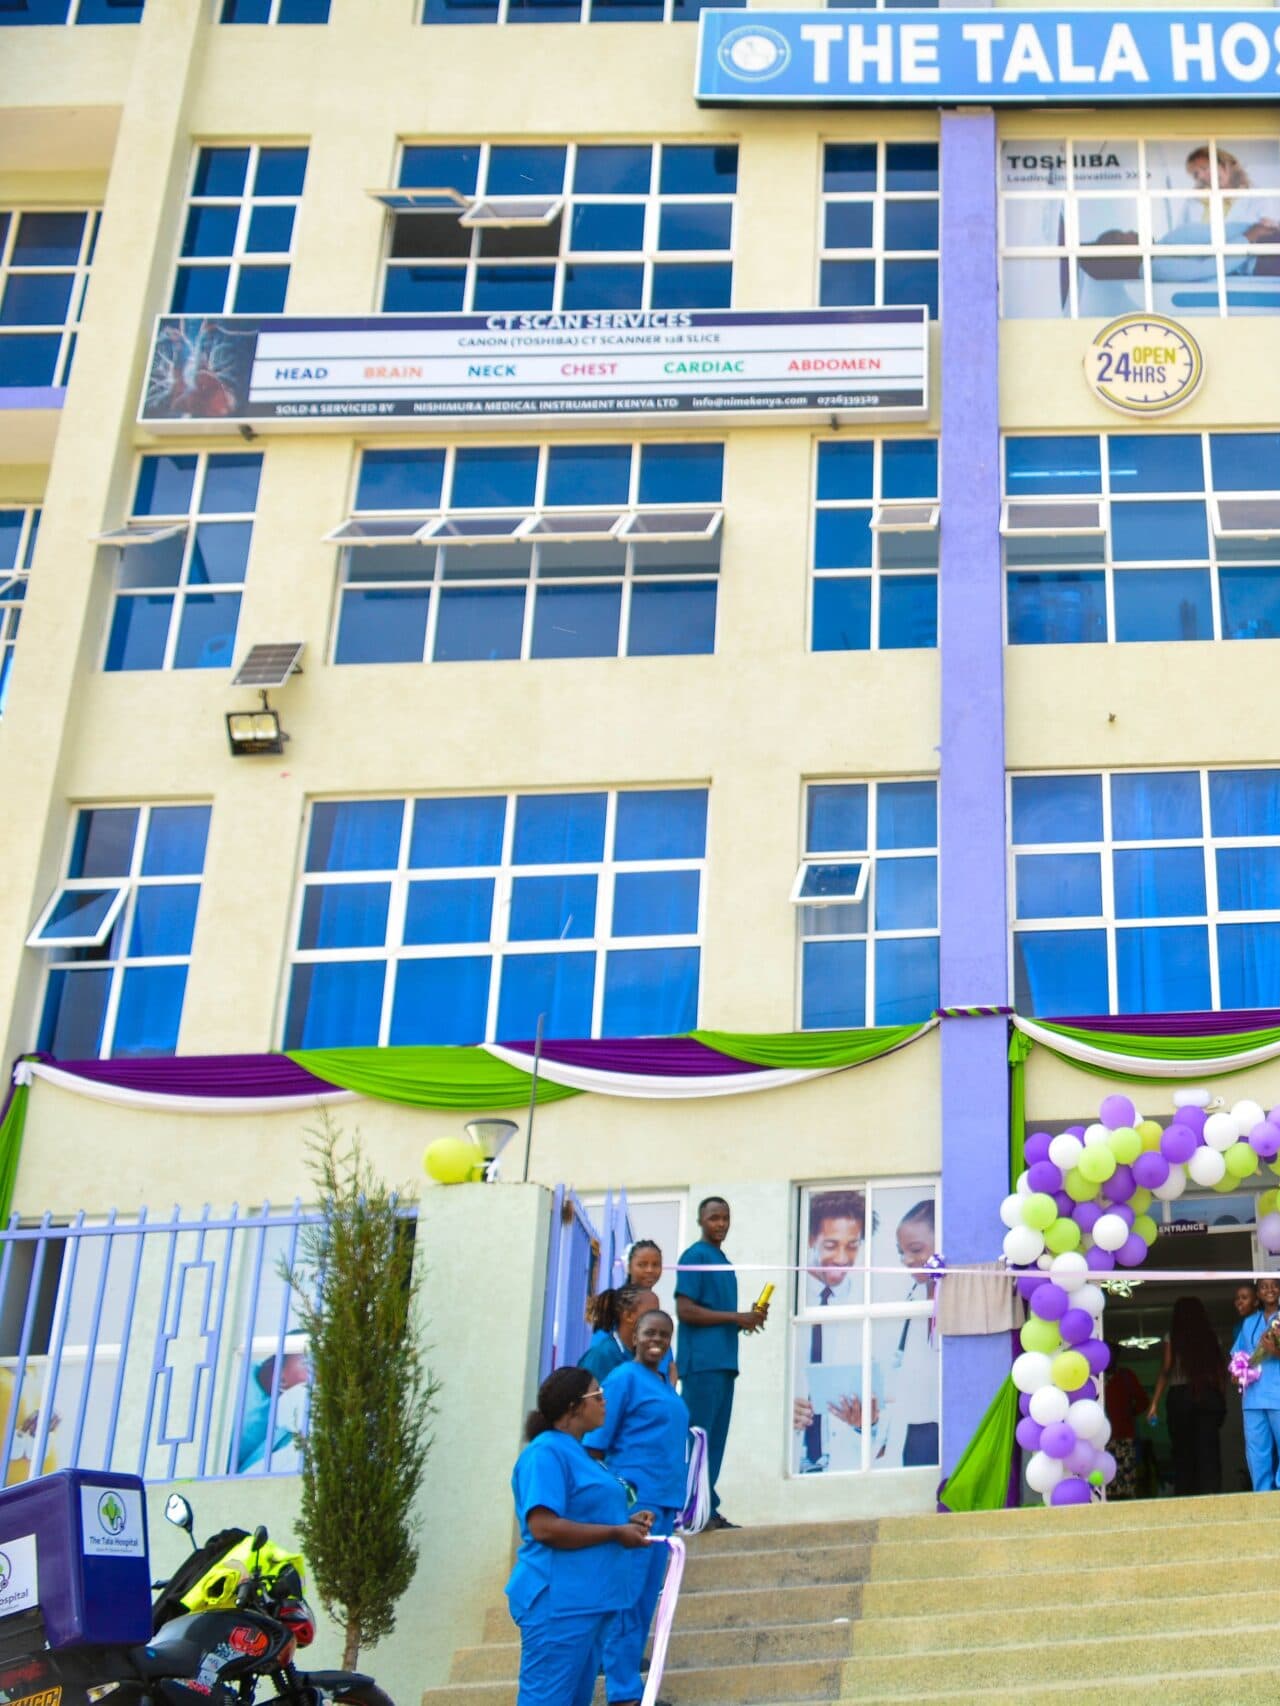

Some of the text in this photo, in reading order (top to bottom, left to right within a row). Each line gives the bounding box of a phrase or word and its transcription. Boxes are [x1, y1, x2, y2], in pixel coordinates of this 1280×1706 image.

[800, 24, 941, 84] THE
[962, 23, 1150, 83] TALA
[1007, 154, 1120, 169] TOSHIBA
[486, 312, 693, 330] CT SCAN SERVICES
[458, 336, 505, 347] CANON
[510, 335, 579, 349] (TOSHIBA)
[581, 334, 596, 346] CT
[601, 333, 662, 345] SCANNER
[687, 332, 721, 343] SLICE
[1132, 346, 1177, 364] OPEN
[275, 358, 882, 380] HEAD BRAIN NECK CHEST CARDIAC ABDOMEN
[1097, 352, 1167, 383] 24 HRS
[275, 404, 307, 416] SOLD
[309, 404, 318, 414] &
[320, 403, 378, 414] SERVICED
[380, 403, 396, 413] BY
[413, 402, 484, 413] NISHIMURA
[486, 401, 536, 411] MEDICAL
[539, 400, 615, 410] INSTRUMENT
[616, 399, 655, 409] KENYA
[656, 398, 680, 408] LTD
[1158, 1223, 1205, 1233] ENTRANCE
[89, 1536, 139, 1548] The Tala Hospital
